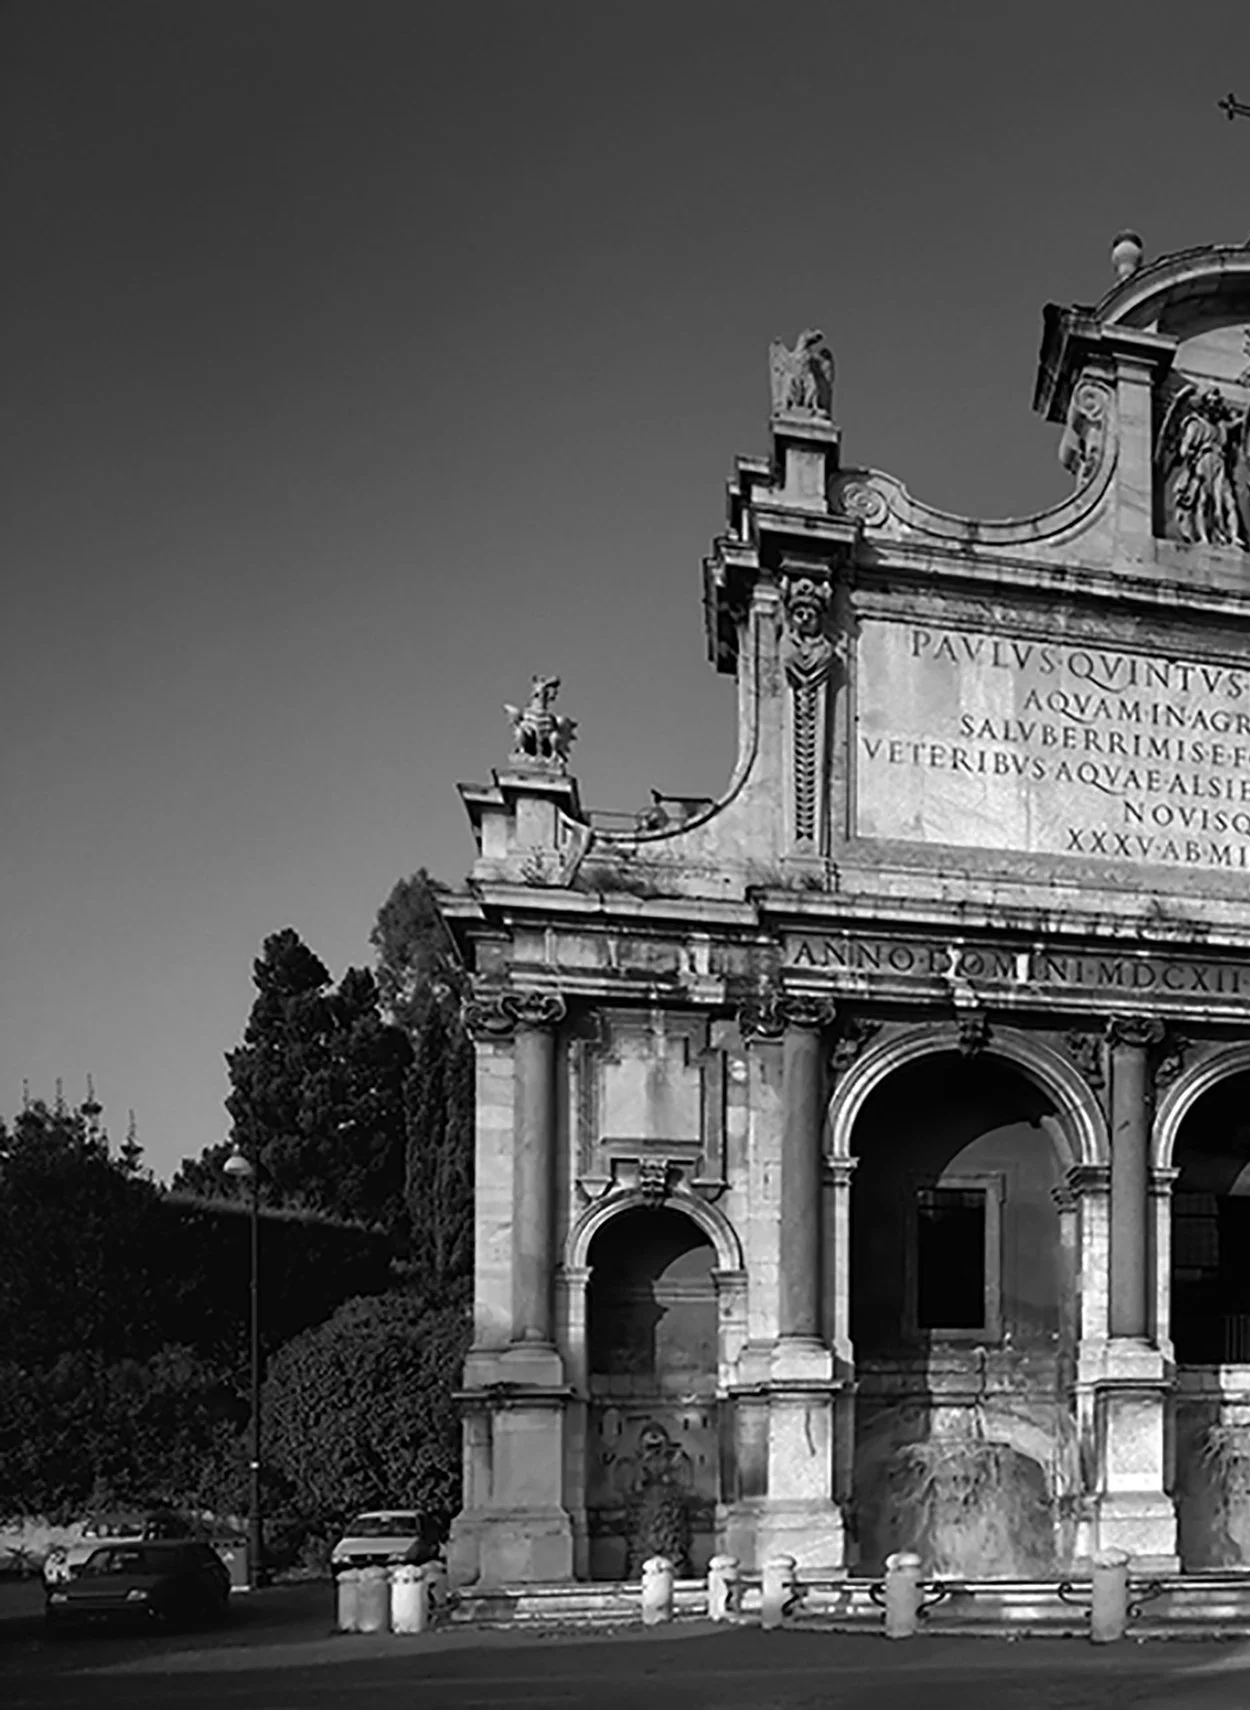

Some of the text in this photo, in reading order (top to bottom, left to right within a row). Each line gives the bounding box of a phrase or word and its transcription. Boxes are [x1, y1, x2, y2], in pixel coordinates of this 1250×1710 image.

[911, 630, 1056, 675] PAVLVS
[1068, 651, 1243, 700] QVINTVS
[1024, 689, 1142, 724] AQVAM
[1152, 704, 1186, 726] IN
[960, 713, 1204, 763] SALVBERRIMIS
[861, 738, 1046, 780] VETERIBVS
[1055, 760, 1161, 796] AQVAE
[1067, 828, 1155, 857] XXXV
[1161, 834, 1201, 862] AB
[793, 940, 915, 973] ANNO
[929, 949, 1083, 984] DOMINI
[1098, 961, 1239, 993] MDCXII
